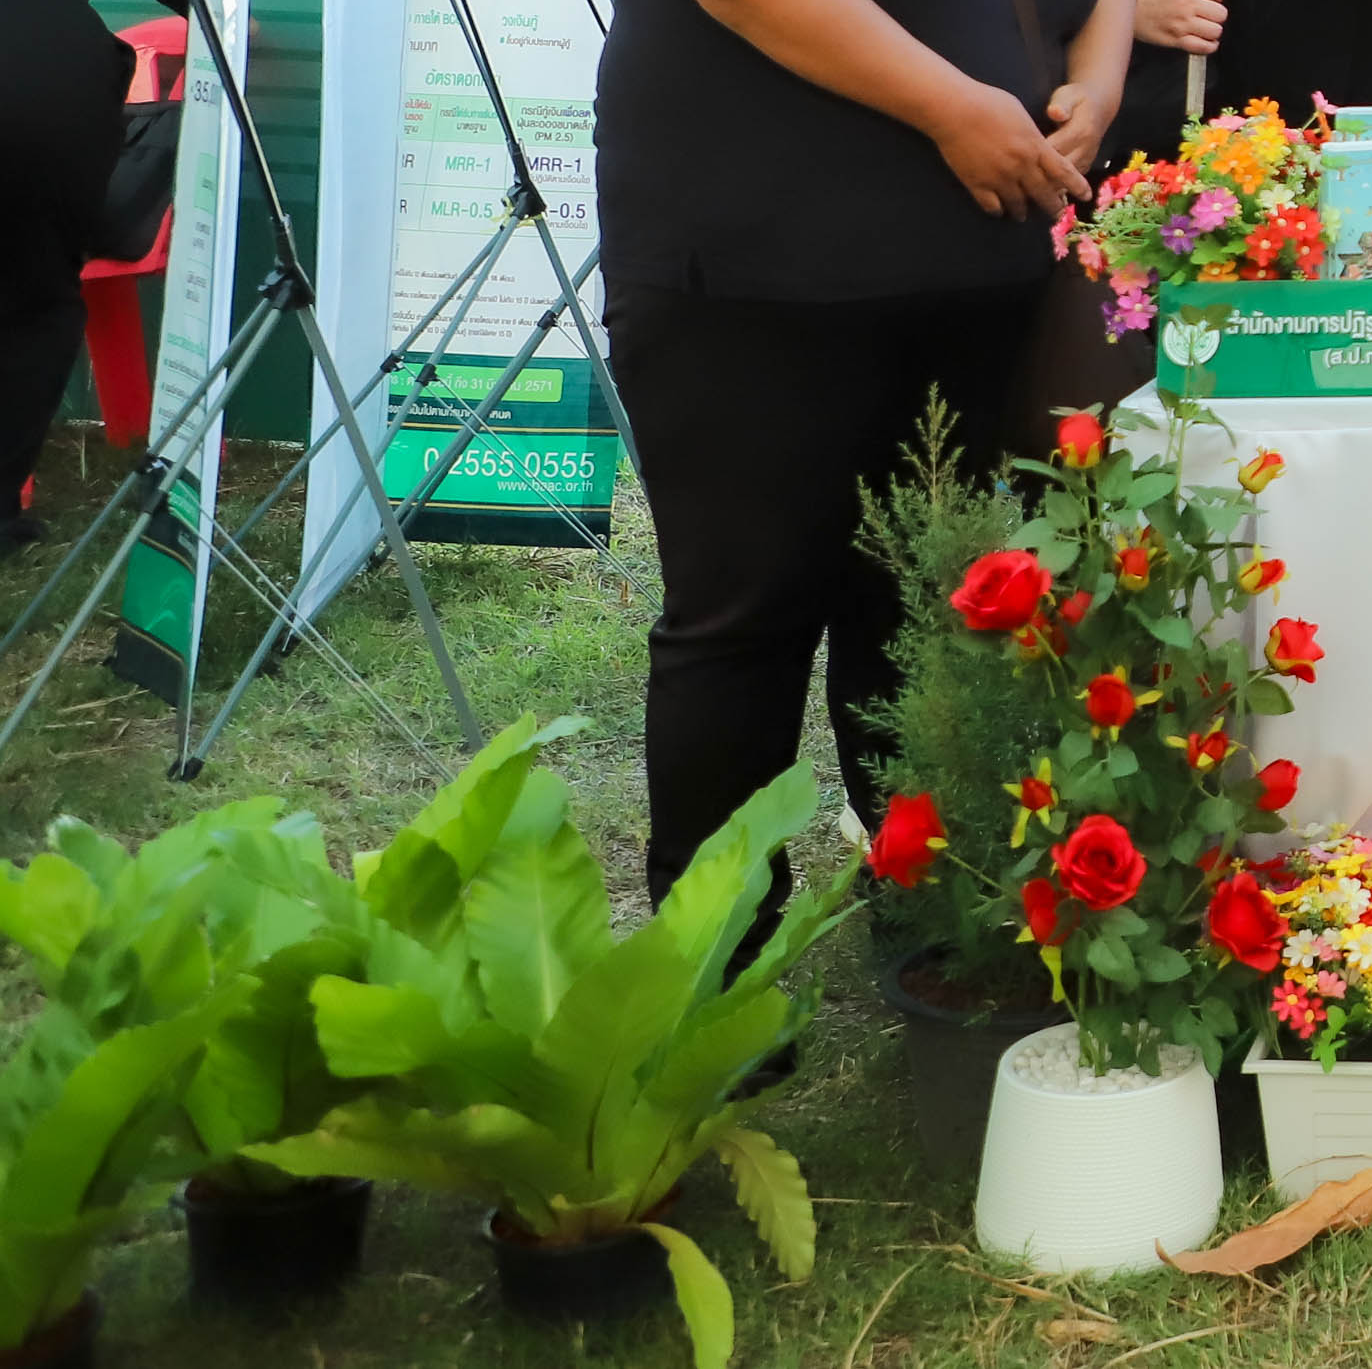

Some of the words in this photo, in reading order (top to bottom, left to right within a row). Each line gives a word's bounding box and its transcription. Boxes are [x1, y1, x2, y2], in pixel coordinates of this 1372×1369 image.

[534, 132, 552, 141] (PM
[555, 132, 573, 142] 2.5)
[445, 156, 491, 172] MRR-1
[431, 202, 494, 218] MLR-0.5
[471, 378, 483, 390] 31
[525, 380, 553, 391] 2571
[523, 451, 595, 479] 0555
